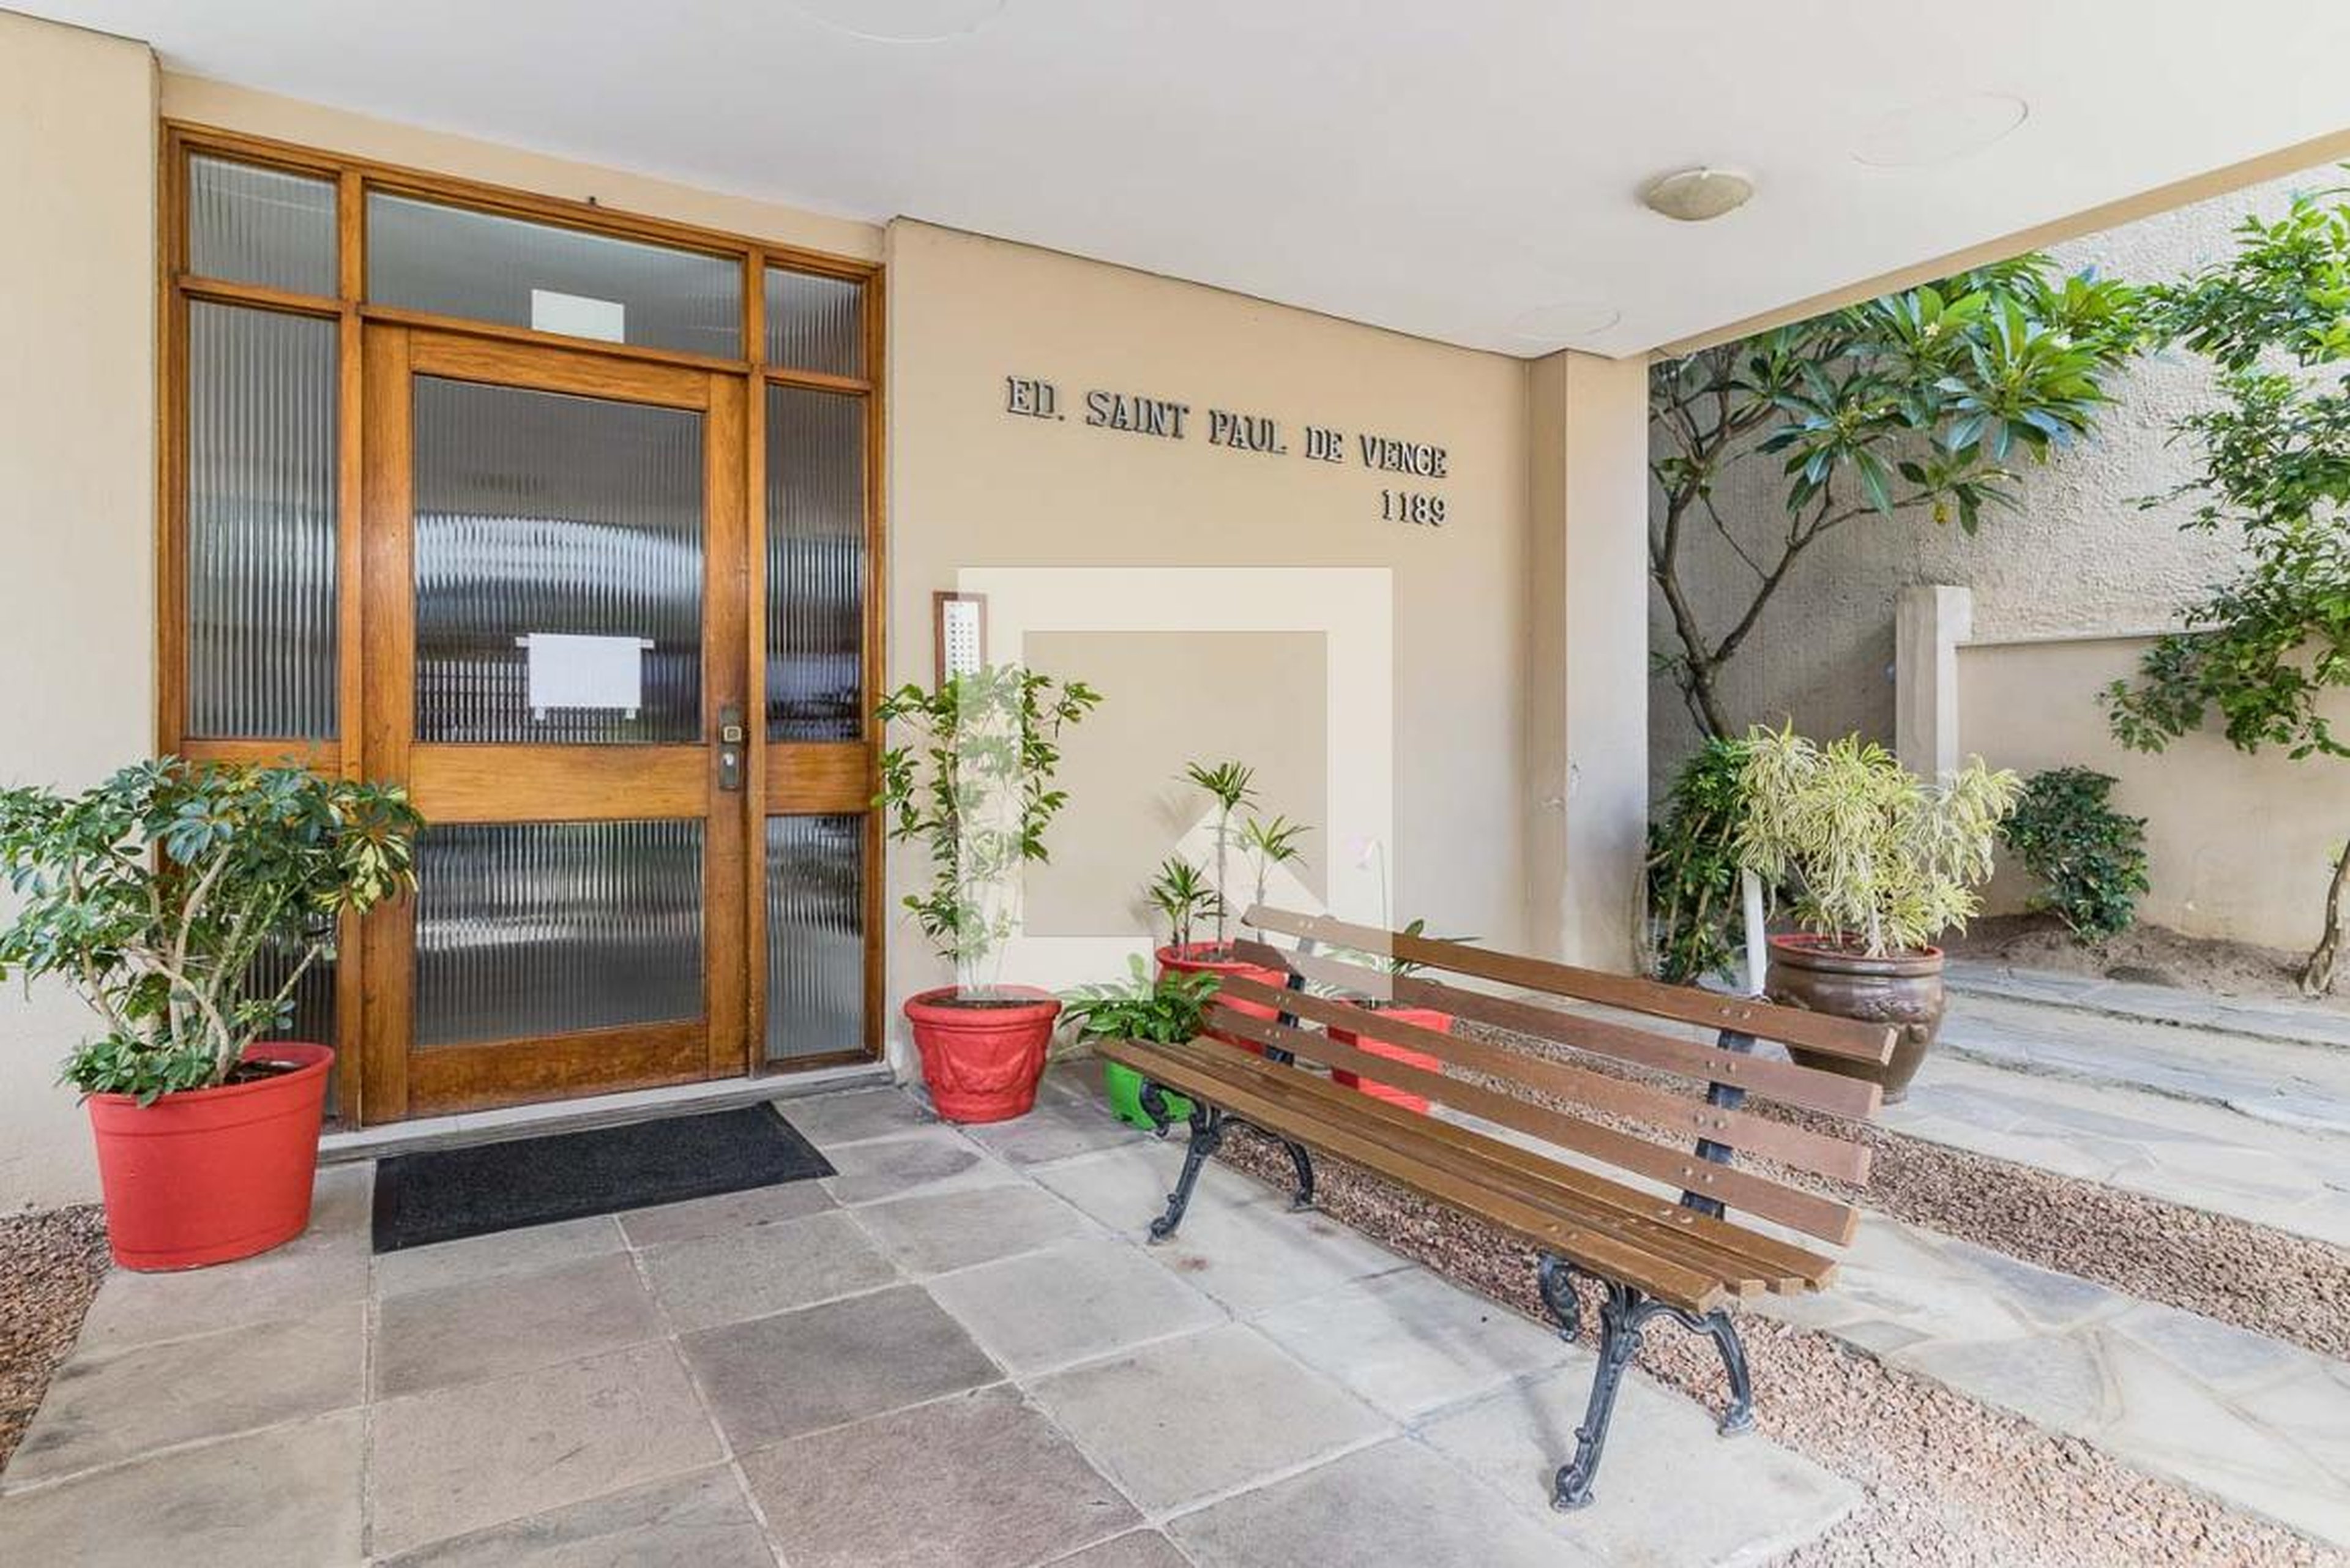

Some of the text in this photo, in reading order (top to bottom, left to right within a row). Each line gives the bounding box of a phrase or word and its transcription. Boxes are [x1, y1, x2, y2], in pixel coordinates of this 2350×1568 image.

[1007, 375, 1447, 479] ED. SAINT PAUL DE VENCE
[1381, 489, 1445, 526] 1189
